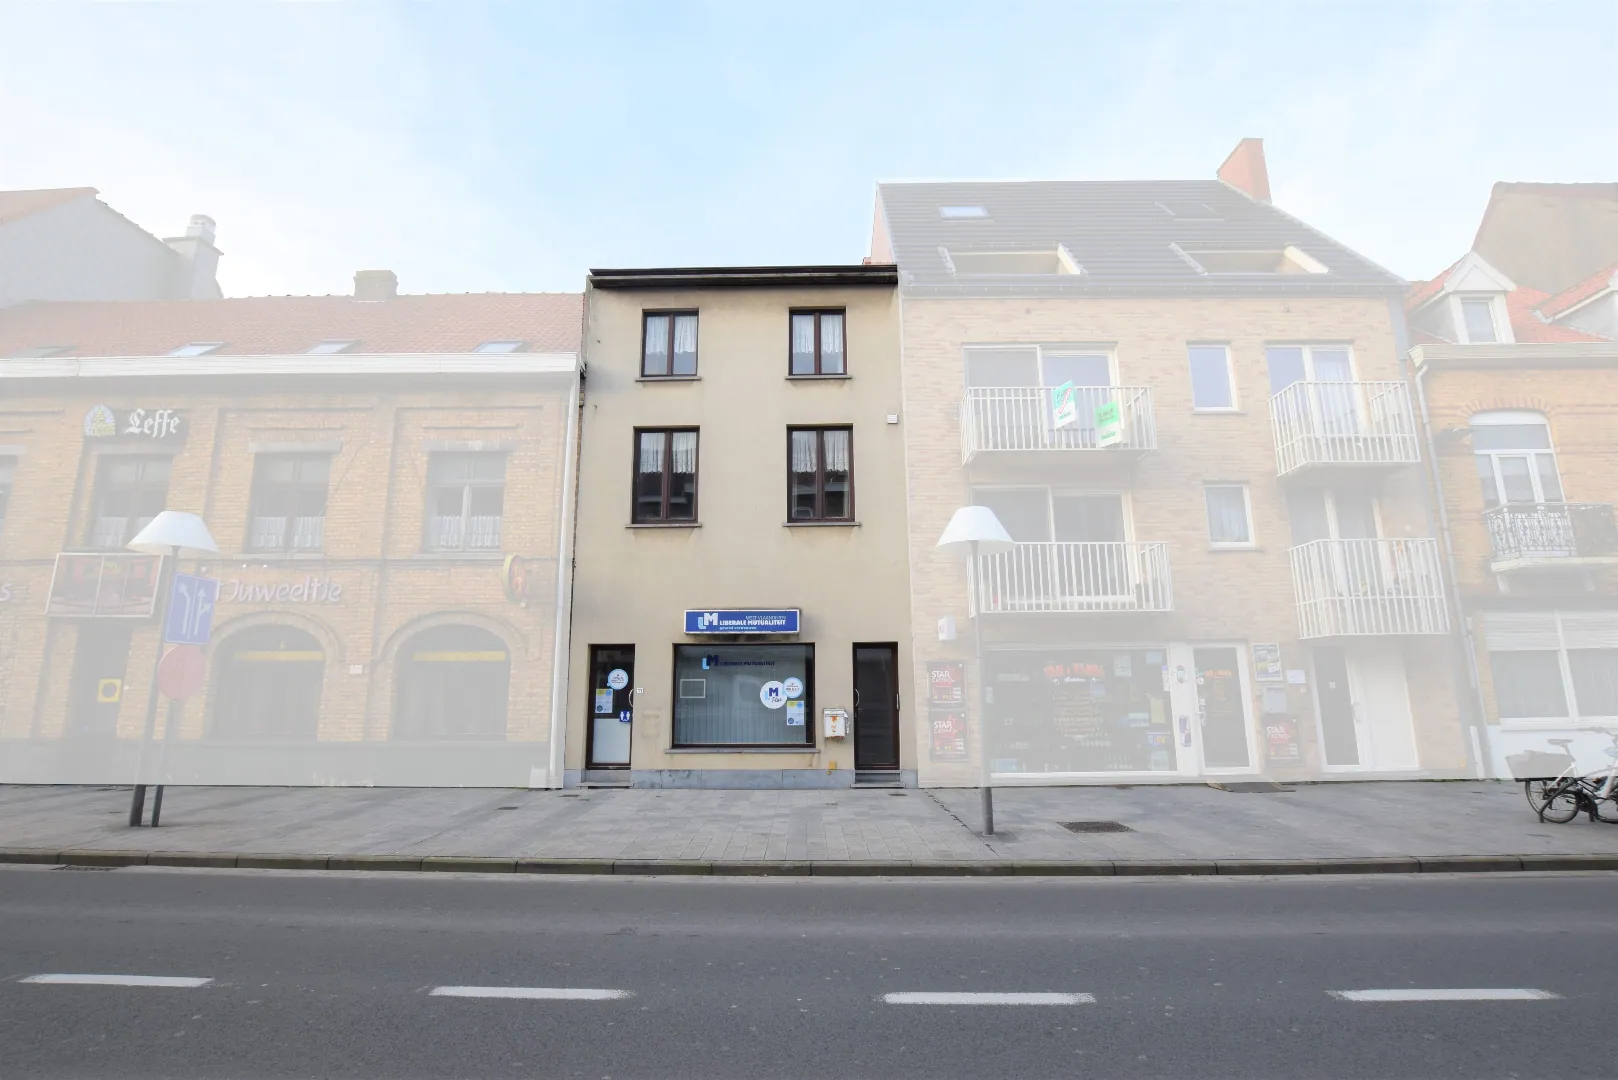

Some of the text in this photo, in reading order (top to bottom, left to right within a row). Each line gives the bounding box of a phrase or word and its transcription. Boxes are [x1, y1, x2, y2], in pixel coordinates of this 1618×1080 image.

[124, 408, 180, 438] Leffe
[229, 575, 344, 604] Juweeltje
[931, 670, 950, 678] STAR
[933, 720, 953, 729] STAR
[1266, 726, 1286, 734] STAR
